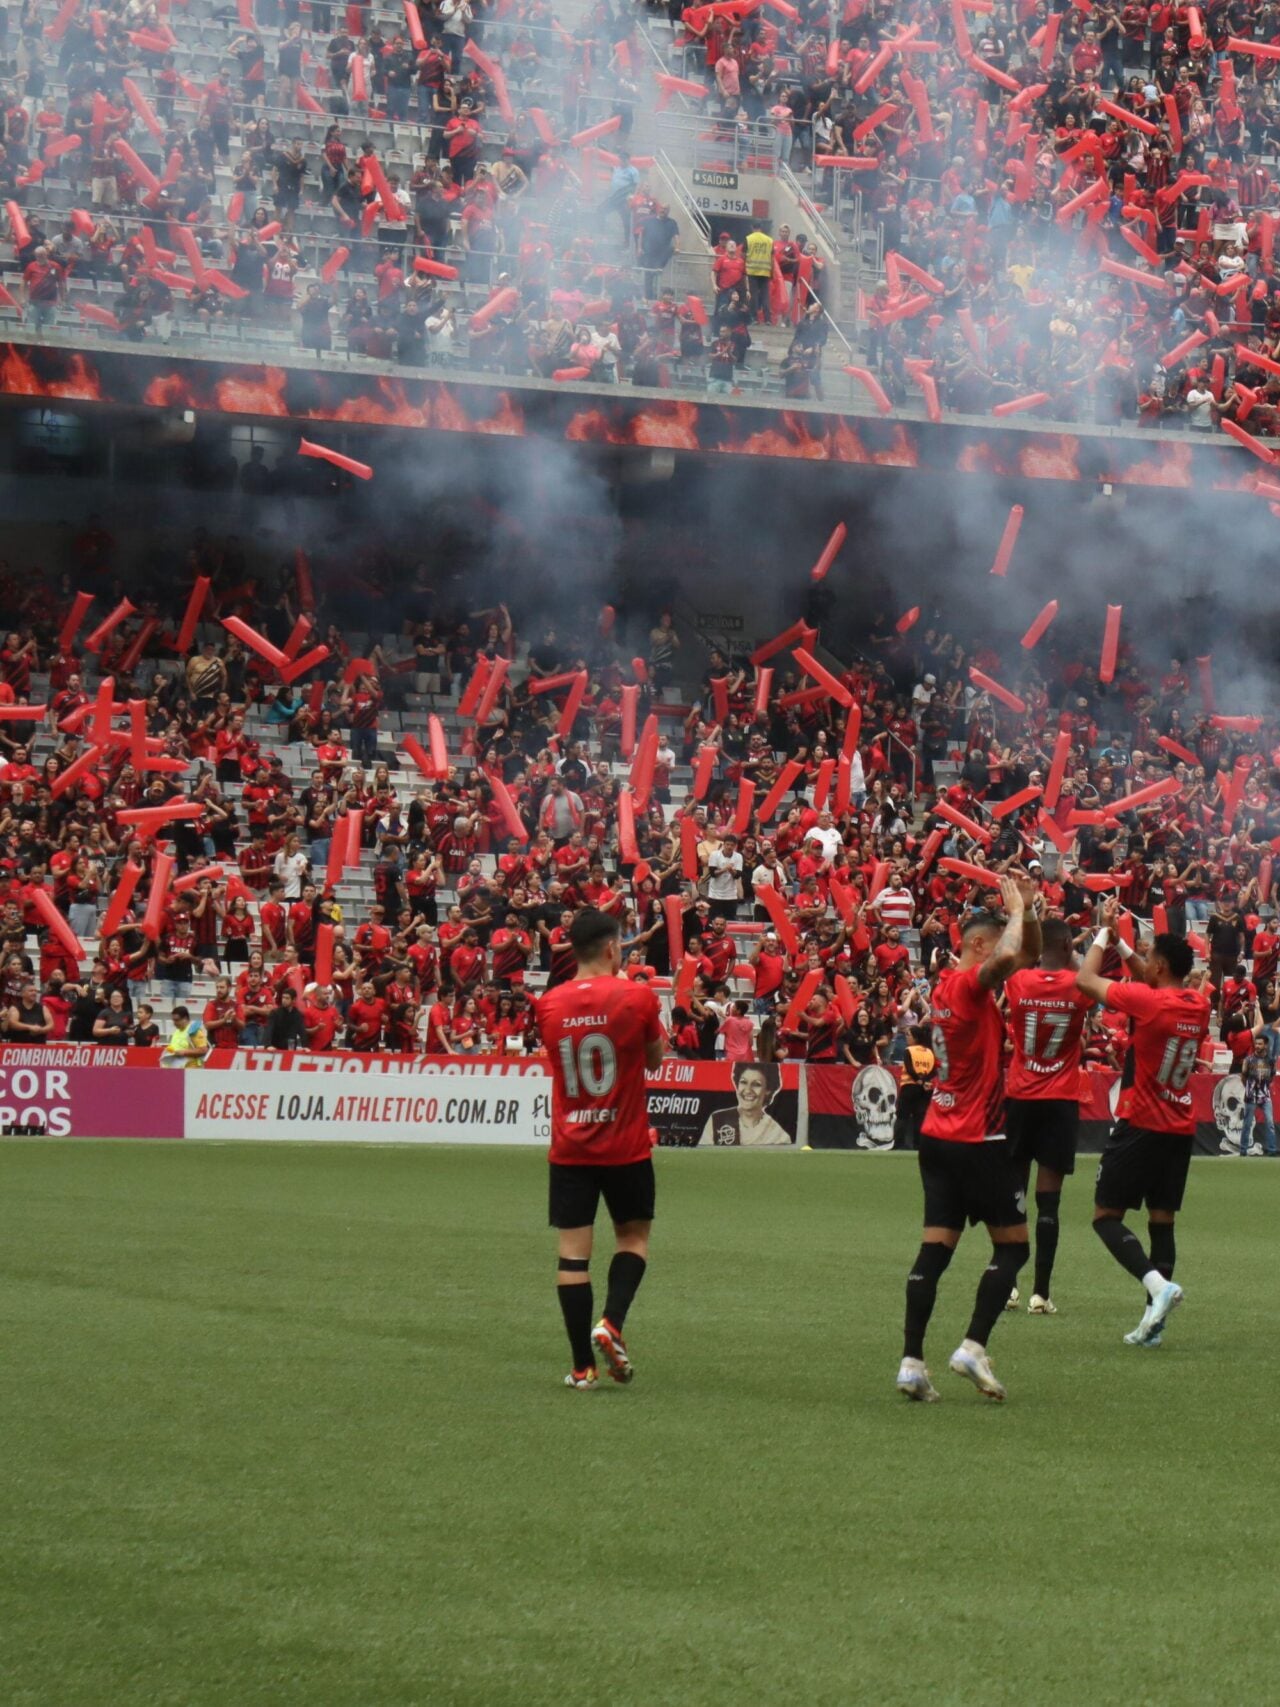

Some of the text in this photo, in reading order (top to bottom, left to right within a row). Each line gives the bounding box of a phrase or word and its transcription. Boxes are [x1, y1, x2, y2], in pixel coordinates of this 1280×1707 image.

[721, 199, 750, 213] 315A
[1018, 998, 1066, 1009] MATHEUS
[562, 1014, 608, 1028] ZAPELLI
[1024, 1010, 1071, 1060] 17
[93, 1049, 128, 1067] MAIS
[558, 1032, 617, 1098] 10
[1157, 1037, 1198, 1091] 18
[666, 1062, 674, 1081] É
[675, 1065, 695, 1083] UM
[0, 1069, 71, 1100] OR
[195, 1093, 270, 1121] ACESSE
[276, 1094, 519, 1125] LOJA.ATHLETICO.COM.BR
[647, 1094, 700, 1115] ESPÍRITO
